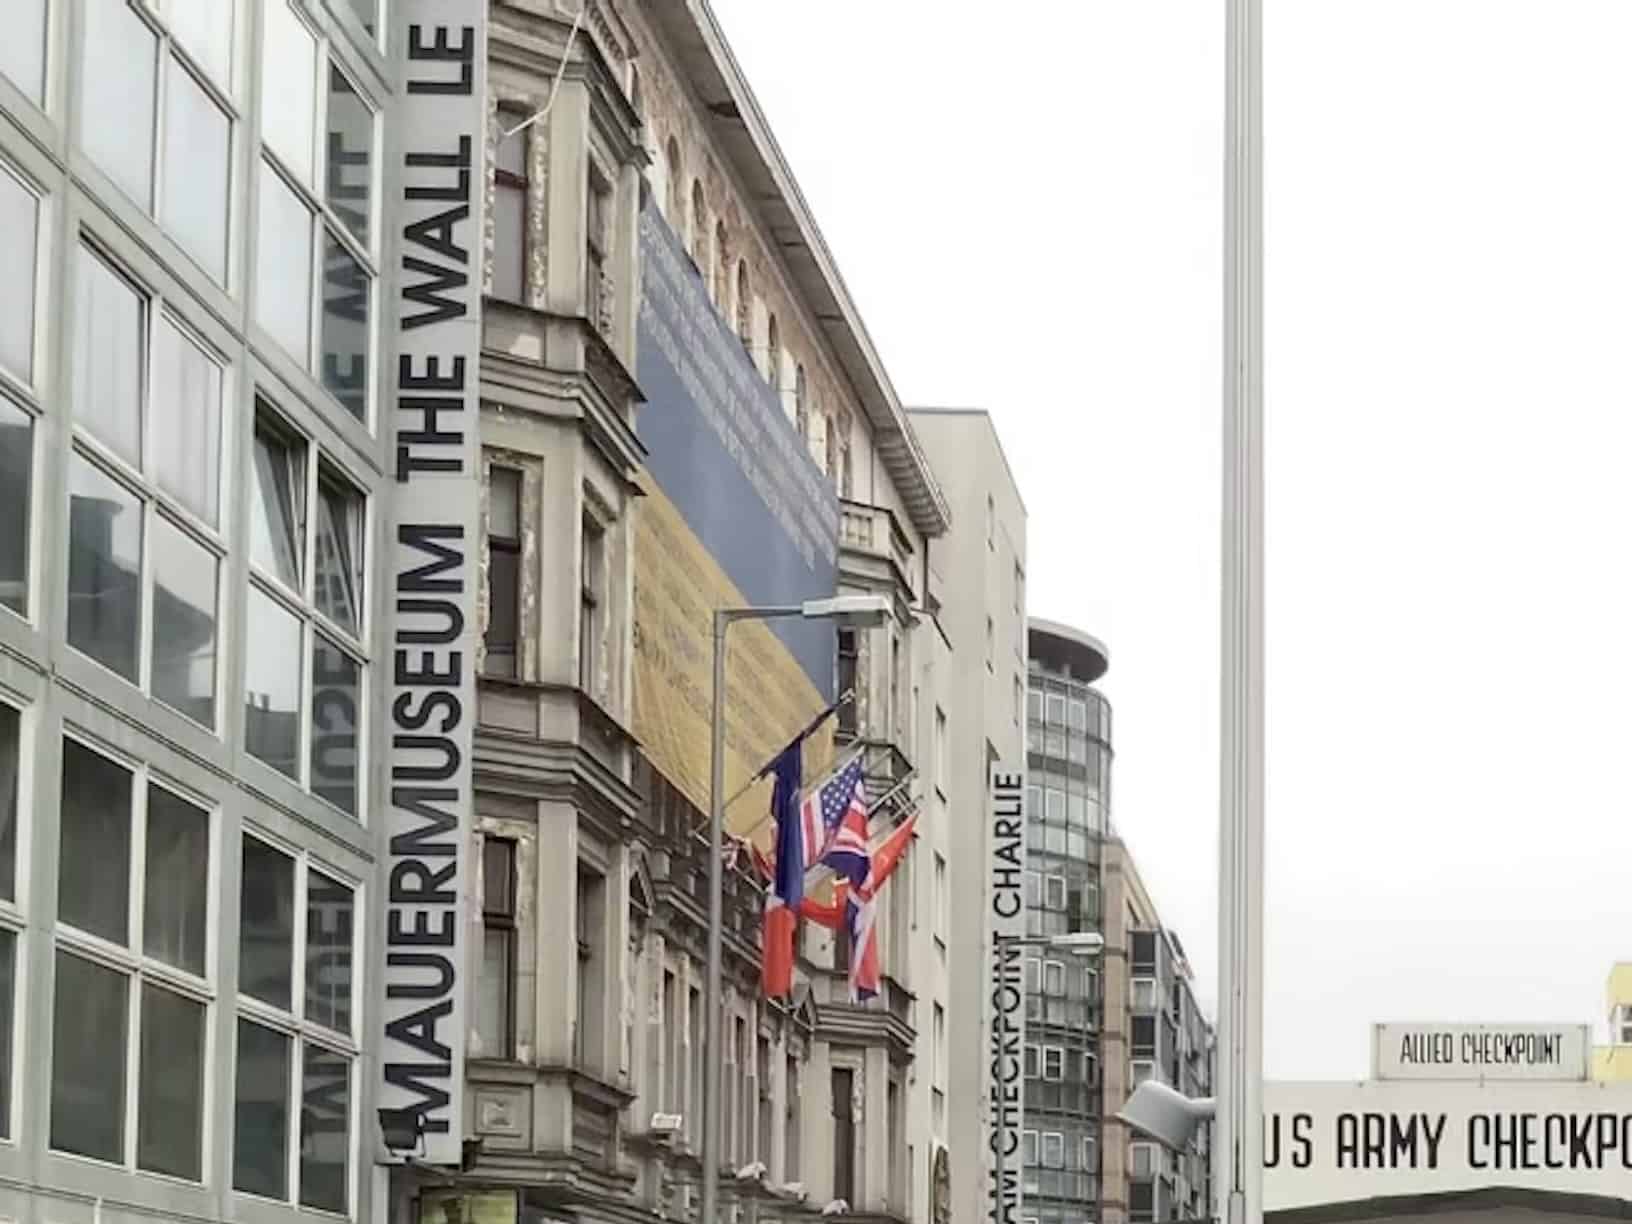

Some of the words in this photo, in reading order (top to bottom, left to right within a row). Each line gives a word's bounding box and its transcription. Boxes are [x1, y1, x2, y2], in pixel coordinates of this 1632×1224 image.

[407, 25, 475, 95] LE
[401, 135, 472, 330] WALL
[397, 354, 465, 482] THE
[386, 523, 464, 1133] MAUERMUSEUM
[993, 774, 1022, 918] CHARLIE
[990, 931, 1021, 1157] CHECKPOINT
[1400, 1033, 1453, 1064] ALLIED
[1461, 1033, 1563, 1064] CHECKPOINT
[1336, 1113, 1447, 1169] ARMY
